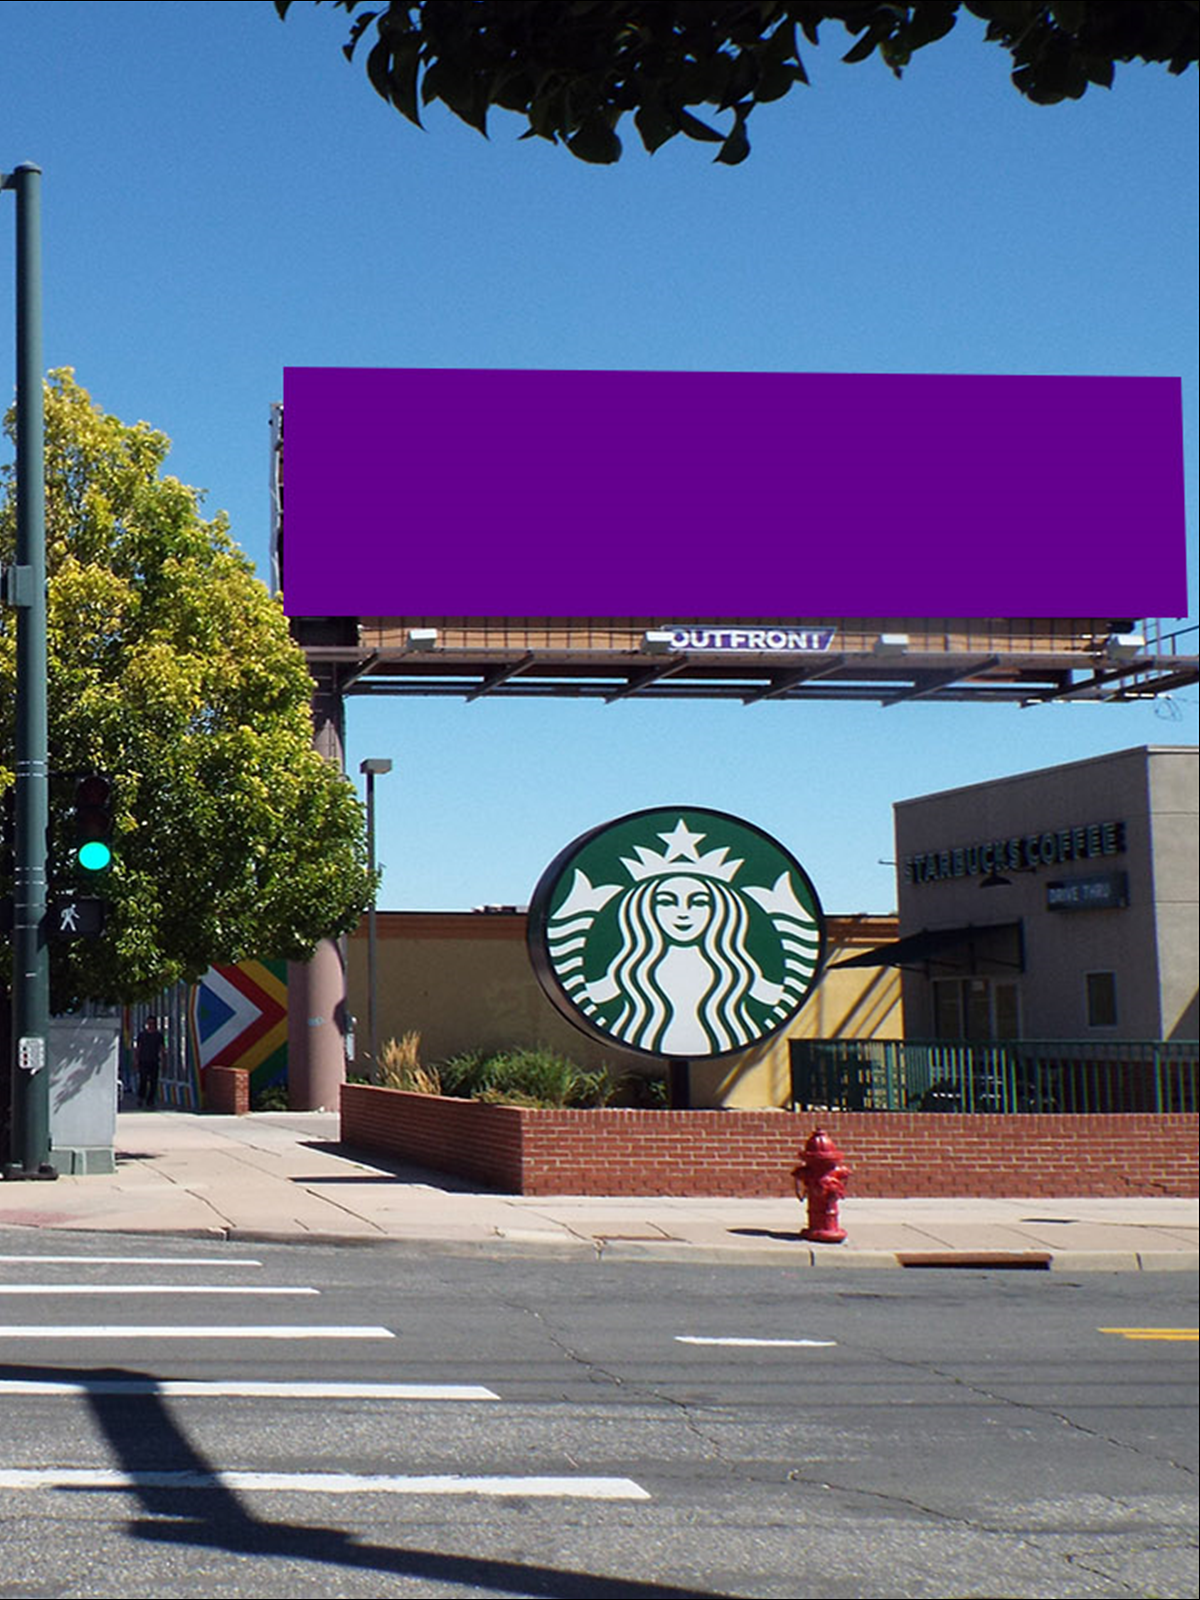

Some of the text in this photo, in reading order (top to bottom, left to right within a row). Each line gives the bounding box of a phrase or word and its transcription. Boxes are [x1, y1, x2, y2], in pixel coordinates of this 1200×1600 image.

[670, 629, 824, 649] OUTFRONT
[904, 822, 1118, 885] STARBUCKS COFFEE
[1048, 886, 1080, 903] DRIVE
